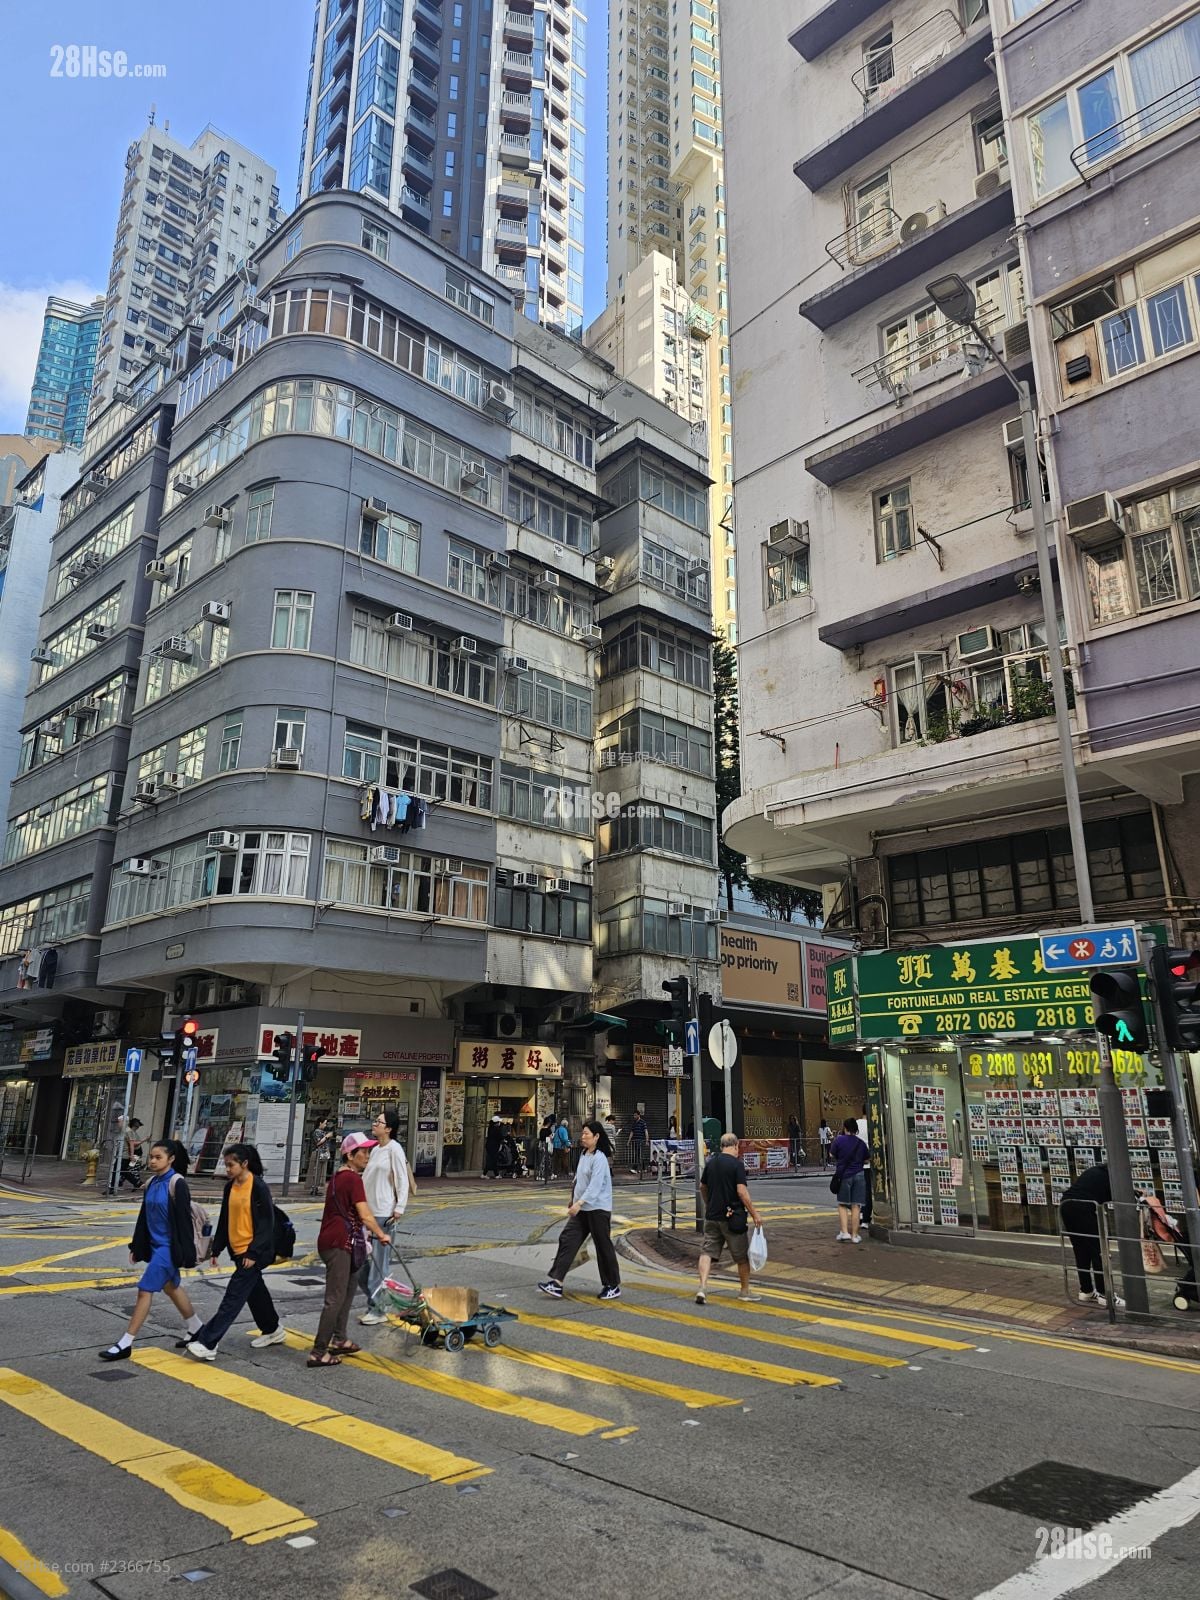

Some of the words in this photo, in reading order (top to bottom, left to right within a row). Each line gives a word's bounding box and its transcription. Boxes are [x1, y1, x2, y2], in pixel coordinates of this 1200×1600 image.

[720, 932, 758, 951] health
[720, 952, 736, 969] op
[737, 954, 778, 975] priority
[888, 993, 965, 1010] FORTUNELAND
[970, 991, 999, 1004] REAL
[1004, 986, 1049, 1001] ESTATE
[1054, 983, 1091, 998] AGEN
[936, 1013, 972, 1032] 2872
[978, 1010, 1016, 1030] 0626
[1036, 1006, 1076, 1027] 2818
[418, 1052, 451, 1061] PROPERTY
[472, 1046, 543, 1071] 粥君好
[987, 1053, 1016, 1075] 2818
[1022, 1052, 1053, 1075] 8331
[1067, 1051, 1101, 1075] 2872
